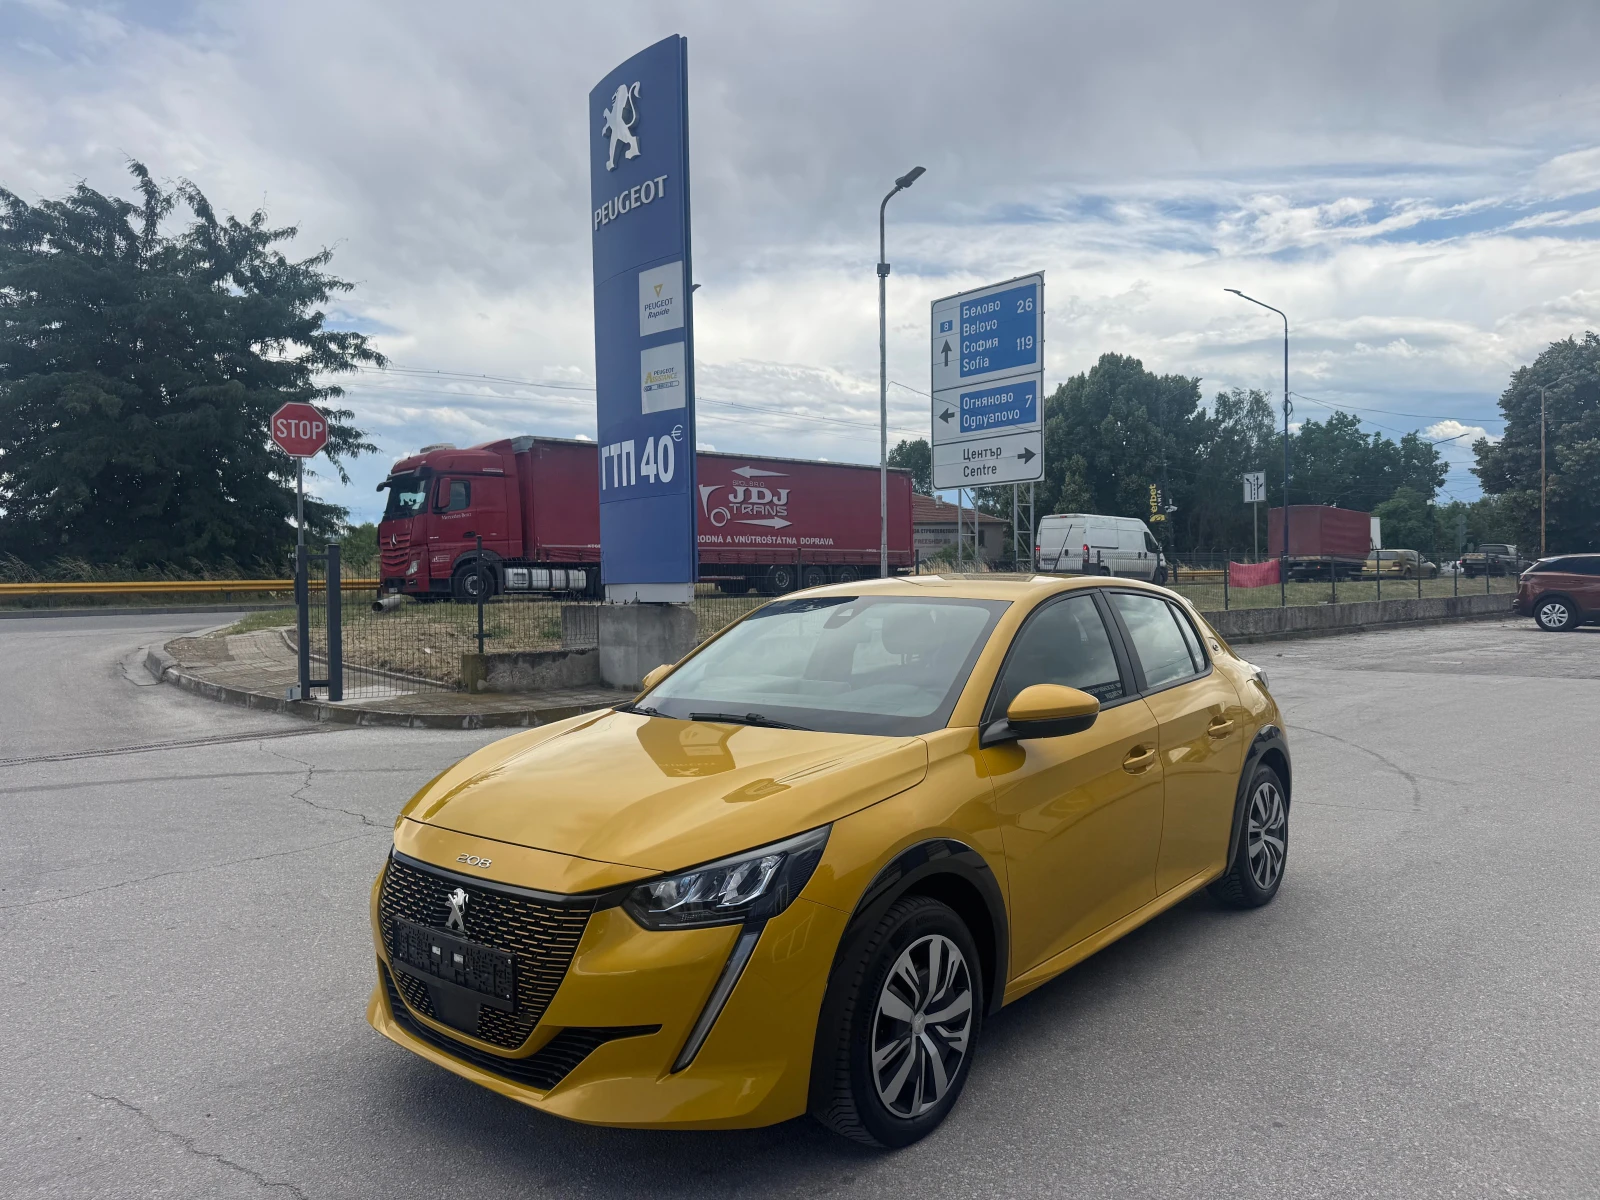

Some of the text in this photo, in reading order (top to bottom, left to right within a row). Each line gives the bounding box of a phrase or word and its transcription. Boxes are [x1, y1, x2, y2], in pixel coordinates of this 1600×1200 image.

[594, 174, 668, 232] PEUGEOT
[644, 297, 673, 311] PEUGEOT
[963, 297, 1033, 319] Белово 26
[648, 308, 670, 319] Rapide
[943, 322, 949, 332] 8
[963, 318, 998, 337] Belovo
[963, 335, 1033, 354] София 119
[653, 367, 674, 376] PEUGEOT
[963, 355, 990, 372] Sofia
[963, 392, 1033, 410] Огняново 7
[963, 408, 1020, 429] Ognyanovo
[276, 418, 324, 440] STOP
[963, 446, 1002, 462] Център
[601, 439, 636, 491] ГТП
[963, 465, 997, 478] Centre
[728, 485, 791, 505] JDJ
[1149, 483, 1158, 513] efbet
[729, 503, 788, 516] TRANS
[726, 535, 733, 543] A
[800, 537, 834, 545] DOPRAVA
[456, 852, 492, 869] 208
